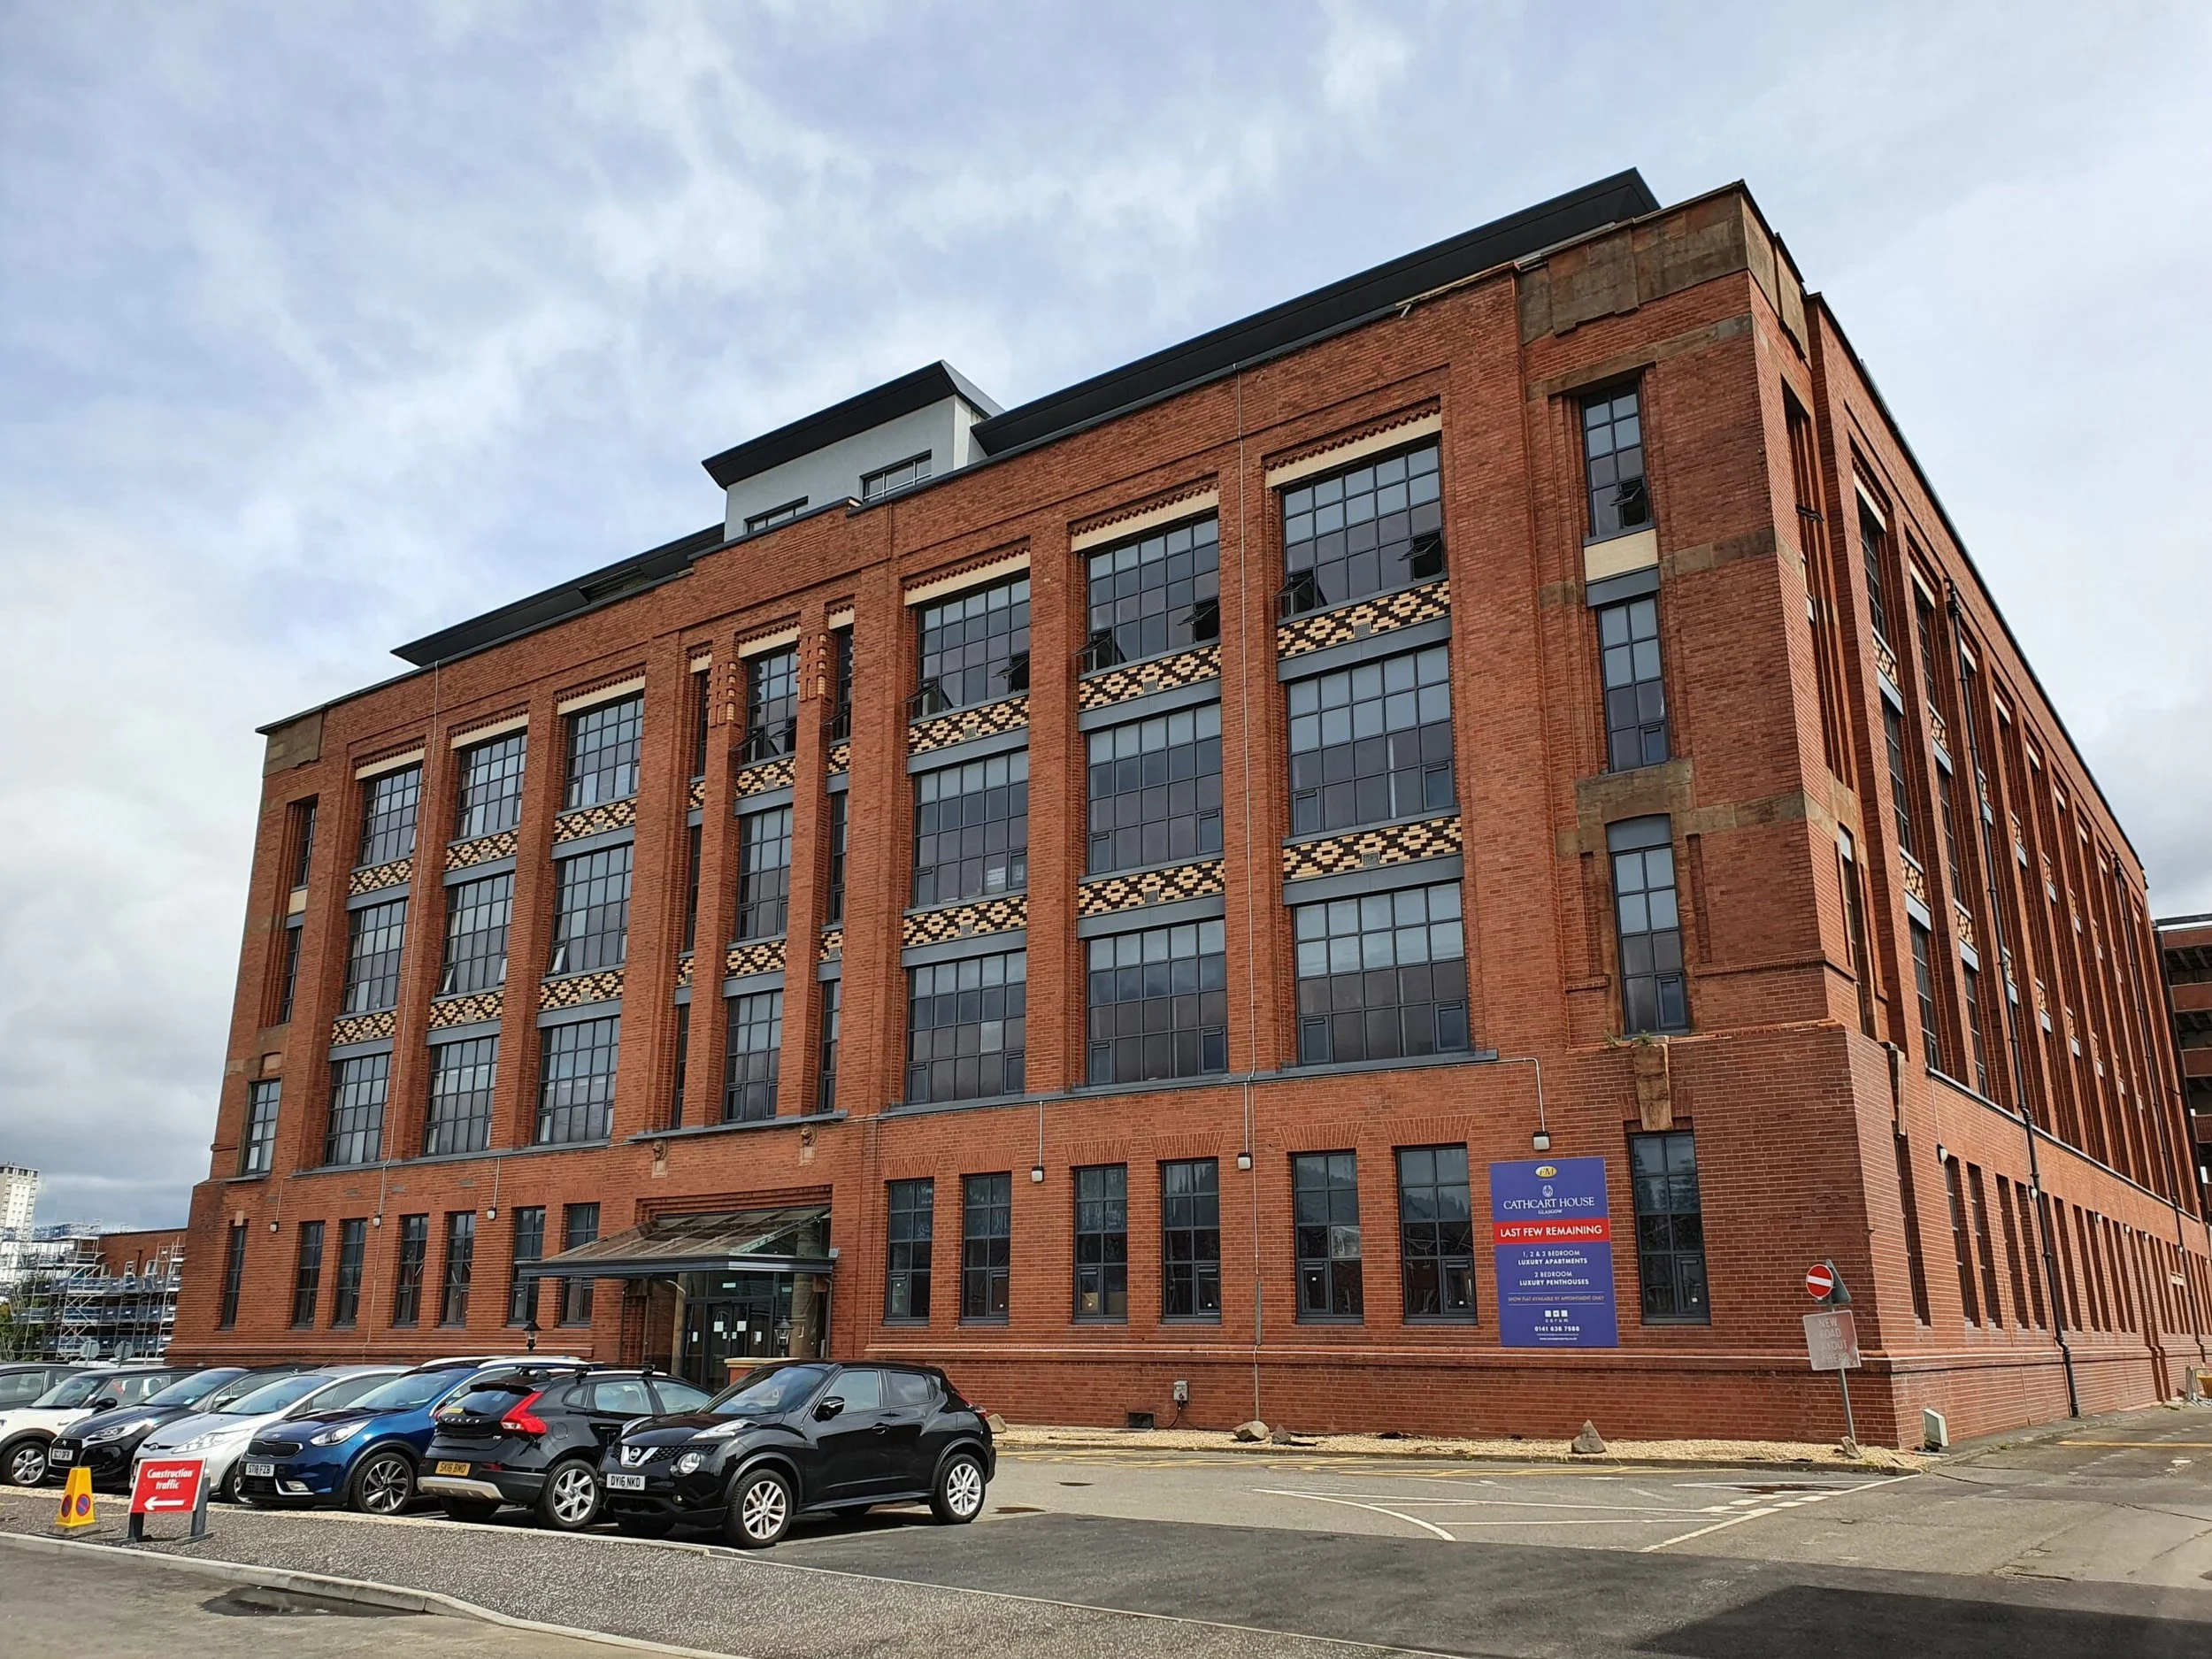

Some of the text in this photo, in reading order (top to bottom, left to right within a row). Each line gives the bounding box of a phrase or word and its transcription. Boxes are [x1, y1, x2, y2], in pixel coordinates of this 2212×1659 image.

[1503, 1196, 1595, 1210] CATHCART HOUSE
[1500, 1225, 1602, 1238] LAST FEW REMAINING
[1818, 1317, 1838, 1328] NEW
[147, 1468, 194, 1479] Construction
[156, 1479, 180, 1490] traffic
[611, 1475, 641, 1487] DY16 NKD
